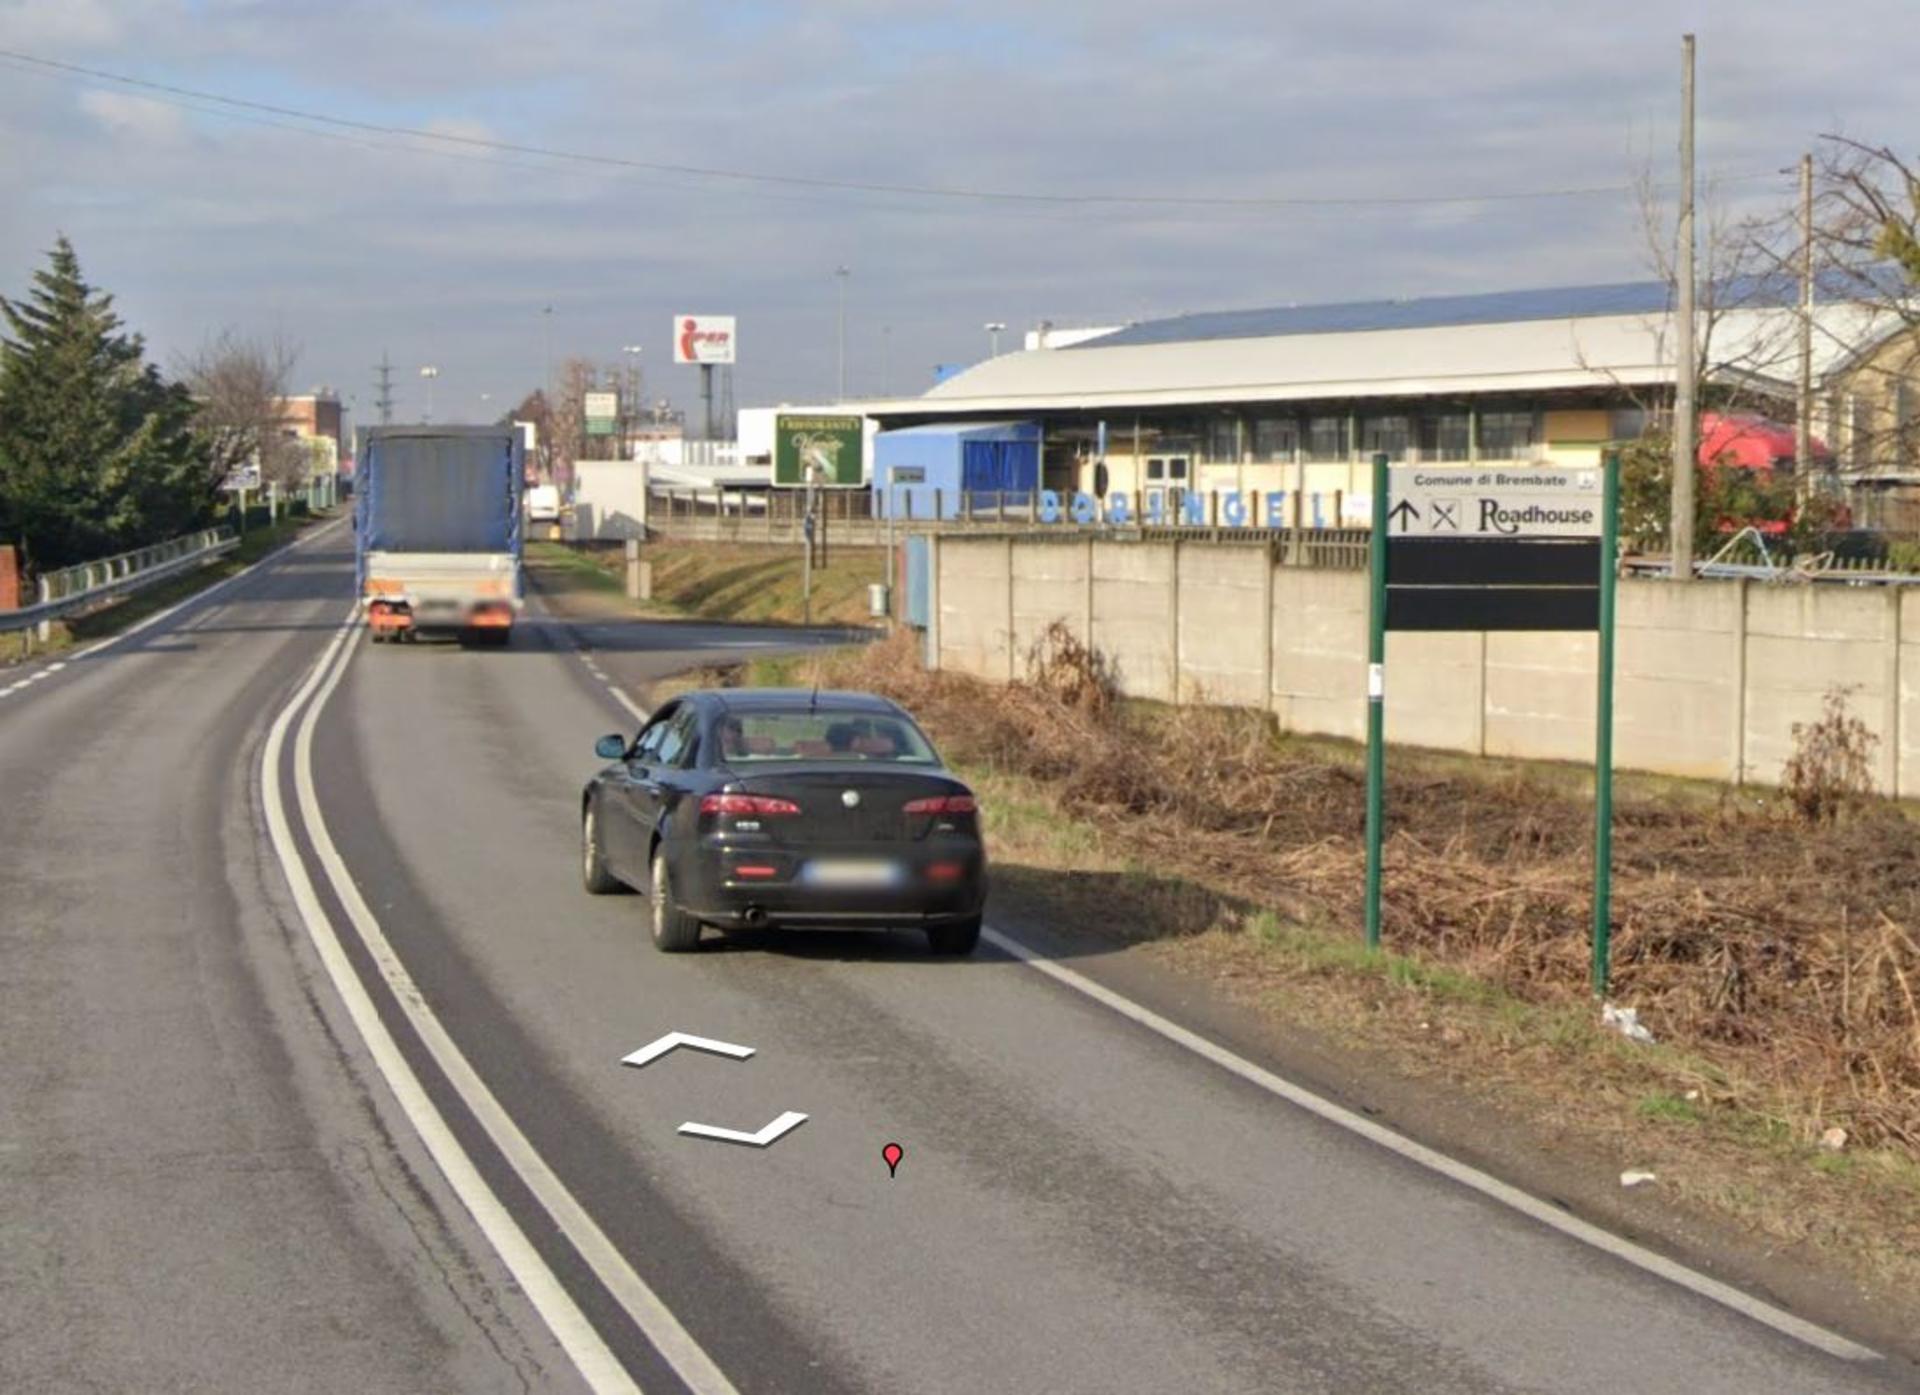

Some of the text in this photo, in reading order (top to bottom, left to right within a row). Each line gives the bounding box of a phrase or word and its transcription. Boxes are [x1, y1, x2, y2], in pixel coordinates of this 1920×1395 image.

[1414, 473, 1567, 487] Comune di Brembate
[1478, 498, 1593, 534] Roadhouse
